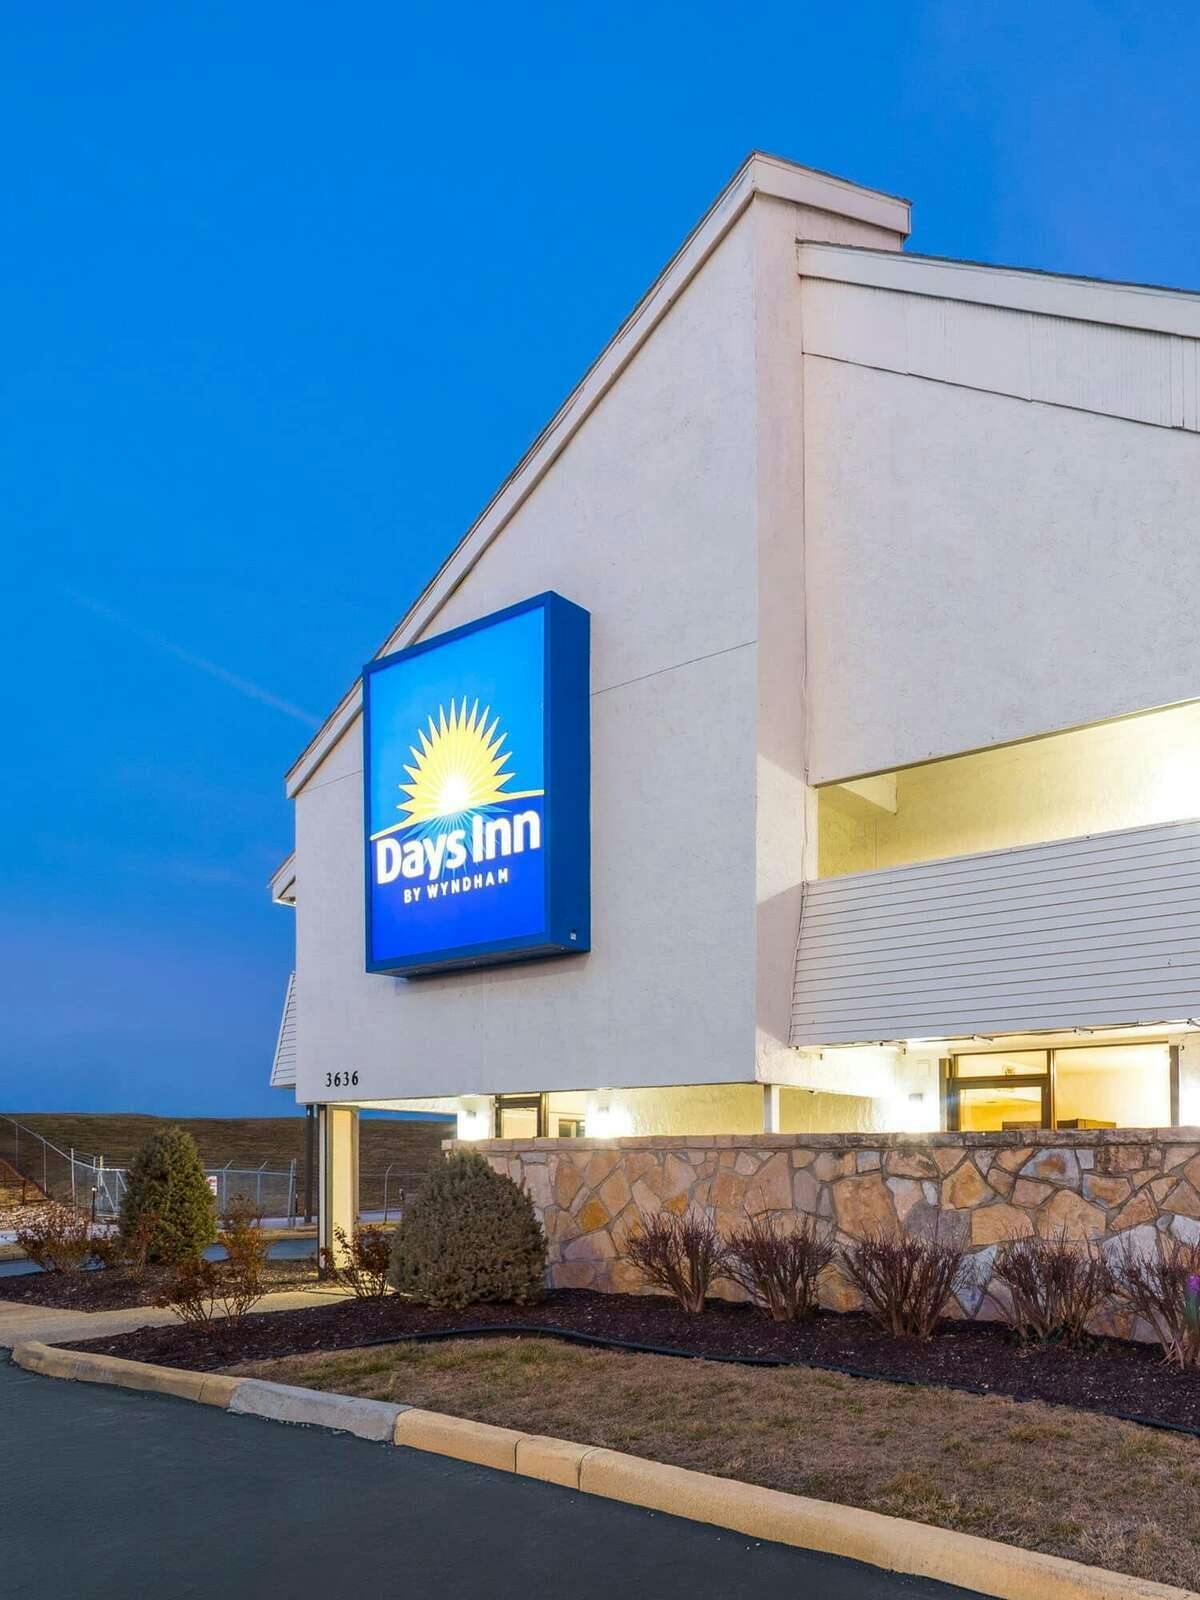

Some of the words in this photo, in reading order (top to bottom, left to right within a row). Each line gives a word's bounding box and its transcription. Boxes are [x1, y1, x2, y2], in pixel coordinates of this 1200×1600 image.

[376, 829, 467, 885] Days
[472, 810, 541, 863] Inn
[403, 887, 421, 904] BY
[427, 868, 509, 899] WYNDHAM
[325, 1070, 359, 1088] 3636
